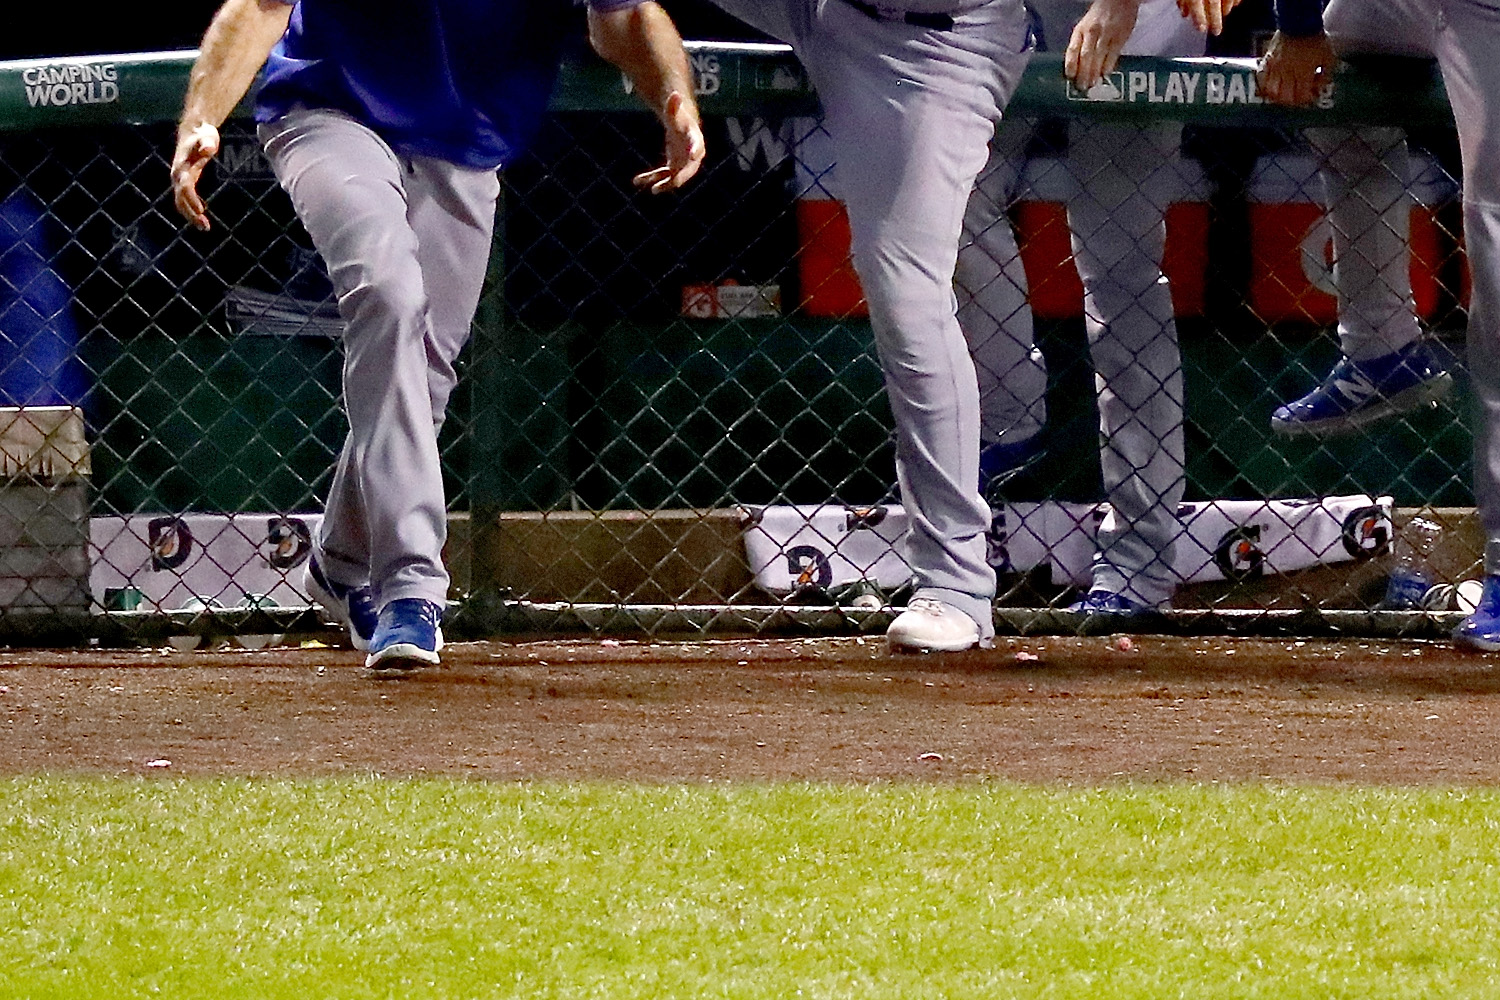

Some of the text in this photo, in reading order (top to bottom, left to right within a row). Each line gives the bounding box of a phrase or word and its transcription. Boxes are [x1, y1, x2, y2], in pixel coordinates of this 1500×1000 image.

[22, 63, 118, 86] CAMPING
[1128, 71, 1268, 104] PLAY BAL
[24, 81, 120, 108] WORLD
